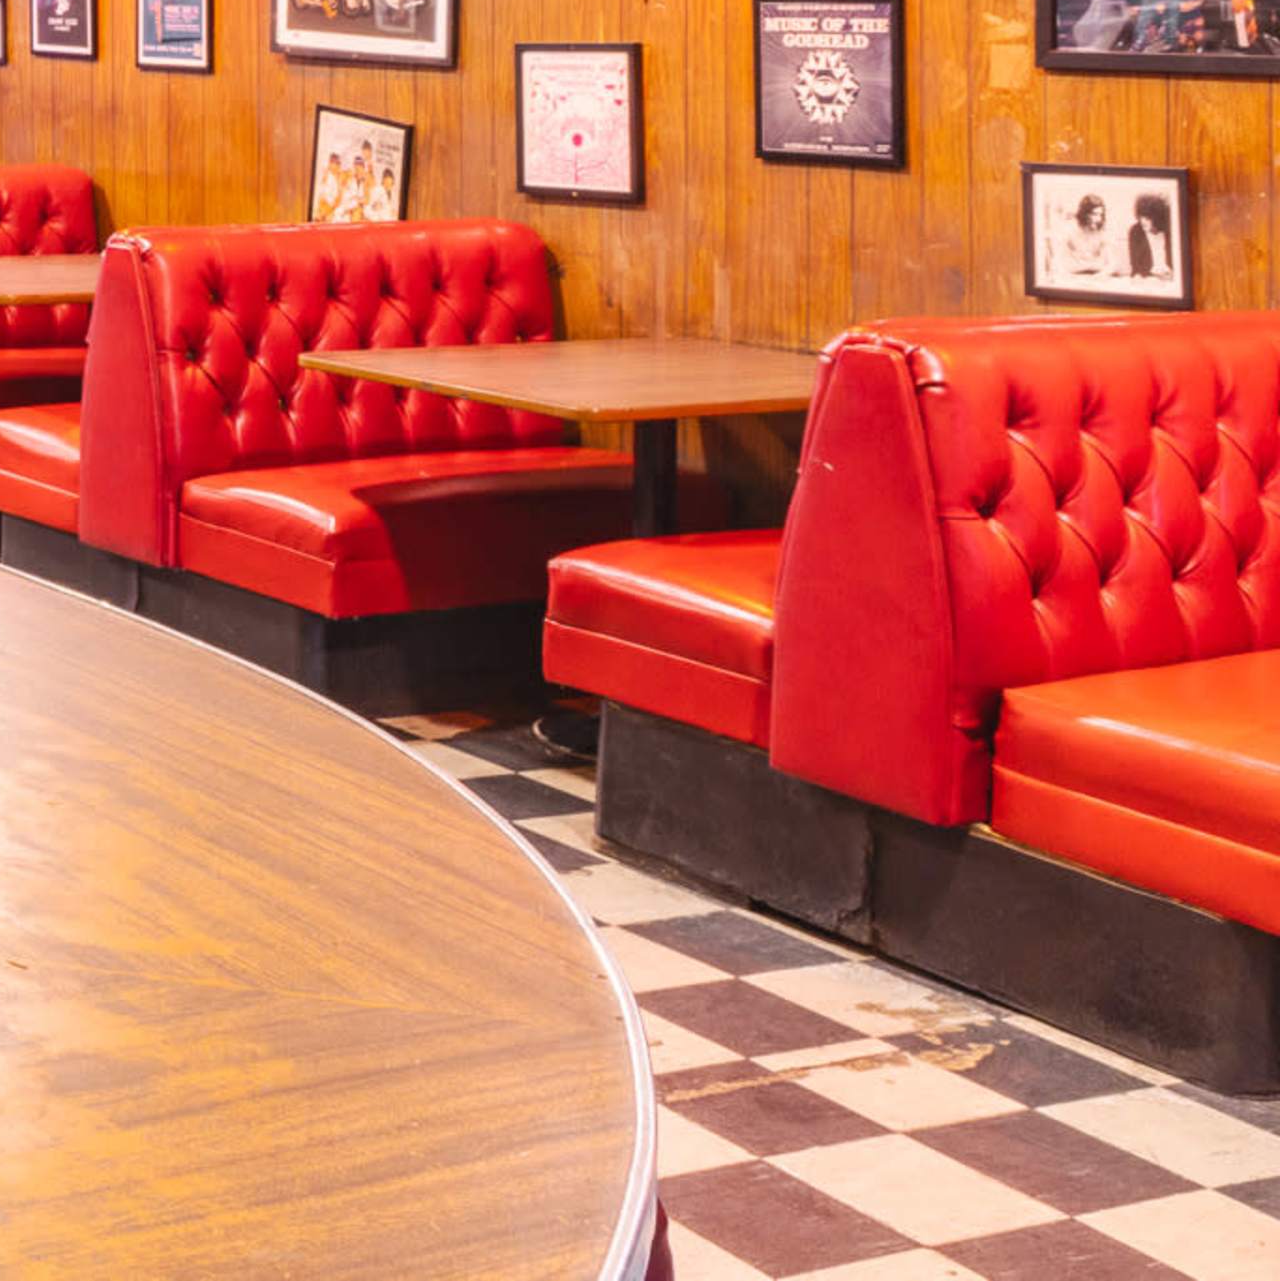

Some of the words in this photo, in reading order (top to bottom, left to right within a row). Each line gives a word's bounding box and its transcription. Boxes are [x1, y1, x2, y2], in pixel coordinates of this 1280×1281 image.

[764, 17, 818, 32] MUSIC
[821, 17, 846, 32] OF
[850, 18, 889, 34] THE
[782, 33, 870, 49] GODHEAD
